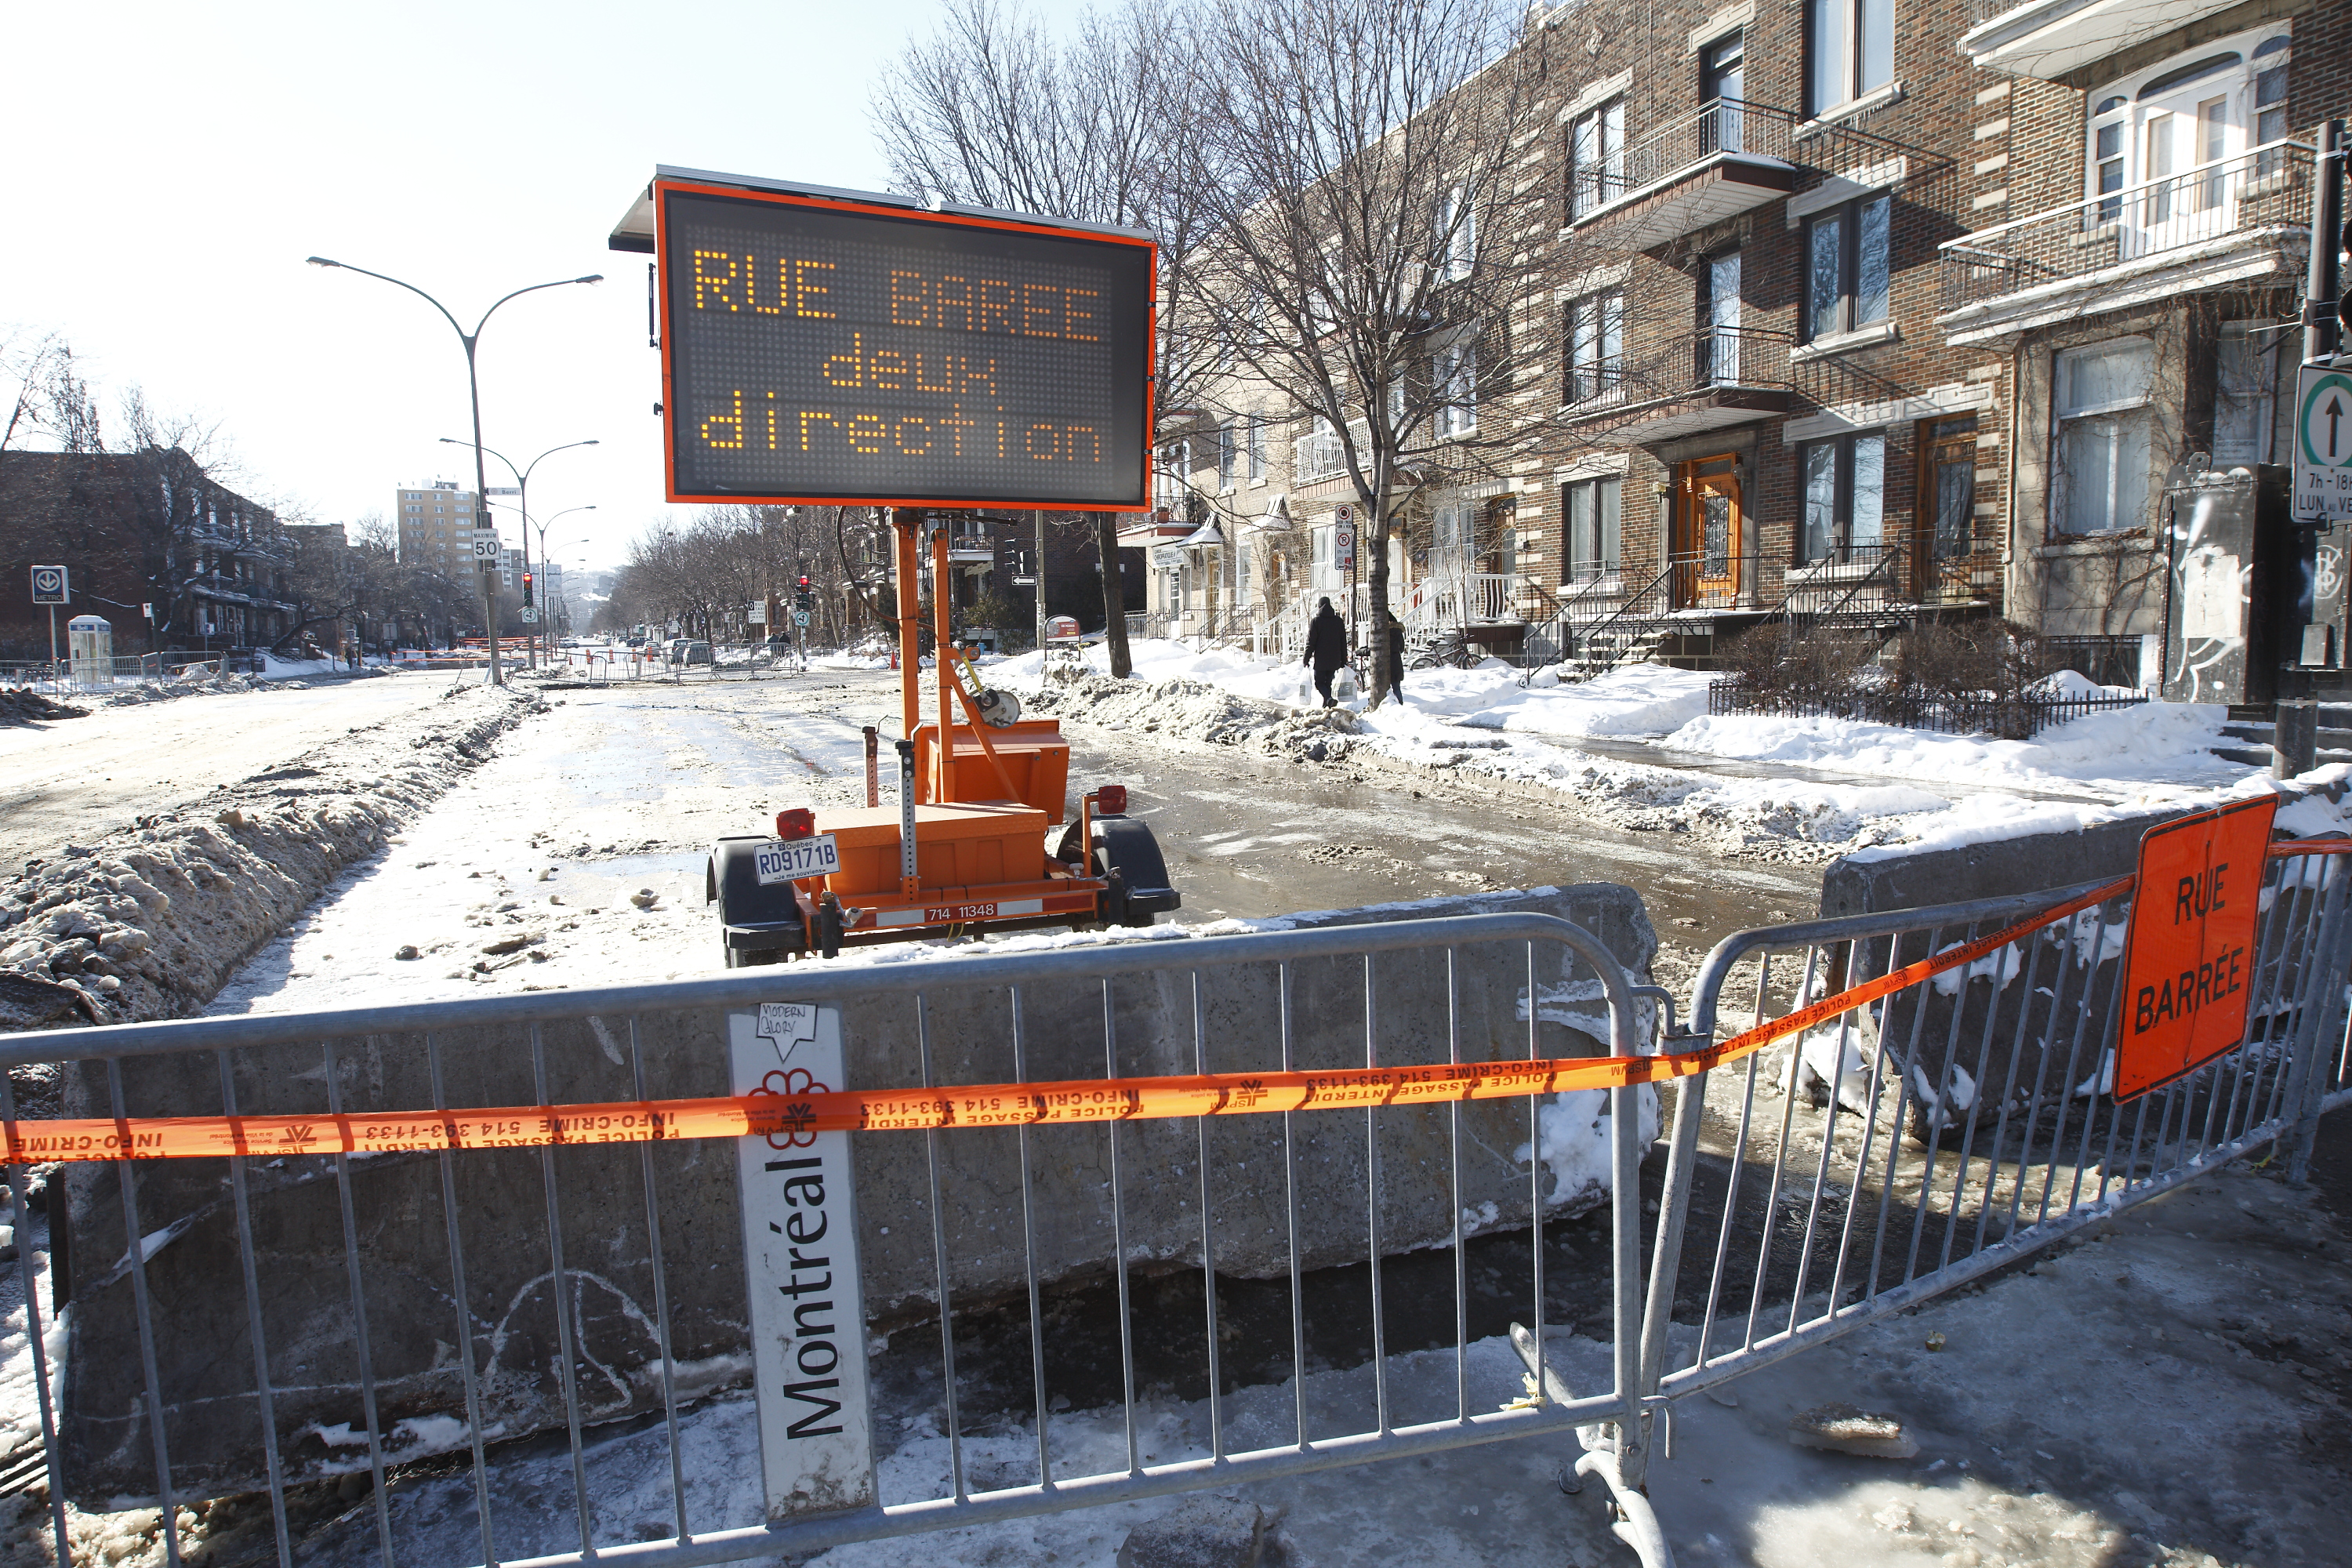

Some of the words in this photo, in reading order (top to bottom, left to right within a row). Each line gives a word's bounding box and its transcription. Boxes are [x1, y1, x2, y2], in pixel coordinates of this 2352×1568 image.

[695, 250, 836, 318] RUE
[891, 270, 1098, 342] BAREE
[823, 332, 996, 394] deux
[701, 390, 1100, 463] direction
[2310, 473, 2323, 488] 7h
[2328, 503, 2336, 512] AU
[475, 541, 497, 555] 50
[786, 841, 814, 850] Québec
[759, 844, 836, 875] RD9171B
[2173, 863, 2229, 926] RUE
[929, 908, 951, 920] 714
[959, 904, 994, 918] 11348
[1974, 927, 2015, 951] PASSAGE
[1929, 946, 1973, 971] INTERDIT
[2134, 943, 2244, 1036] BARRÉE
[1812, 994, 1852, 1019] POLICE
[760, 1016, 796, 1037] GLORY
[1755, 1017, 1807, 1042] PASSAGE
[1446, 1061, 1553, 1080] INFO-CRIME
[1610, 1061, 1642, 1076] SPVM
[1307, 1074, 1391, 1091] 393-1133
[1399, 1071, 1431, 1083] 514
[1490, 1071, 1555, 1087] POLICE
[1302, 1088, 1392, 1103] INTERDIT
[1399, 1080, 1483, 1096] PASSAGE
[965, 1098, 1000, 1112] 514
[1018, 1089, 1139, 1109] INFO-CRIME
[1210, 1100, 1247, 1109] SPVM
[860, 1100, 955, 1116] 393-1133
[1071, 1104, 1145, 1118] POLICE
[539, 1112, 674, 1133] INFO-CRIME
[857, 1116, 956, 1129] INTERDIT
[967, 1109, 1061, 1124] PASSAGE
[366, 1123, 470, 1140] 393-1133
[481, 1121, 521, 1136] 514
[599, 1129, 680, 1142] POLICE
[753, 1125, 794, 1134] SPVM
[13, 1133, 162, 1152] INFO-CRIME
[765, 1157, 843, 1440] Montréal
